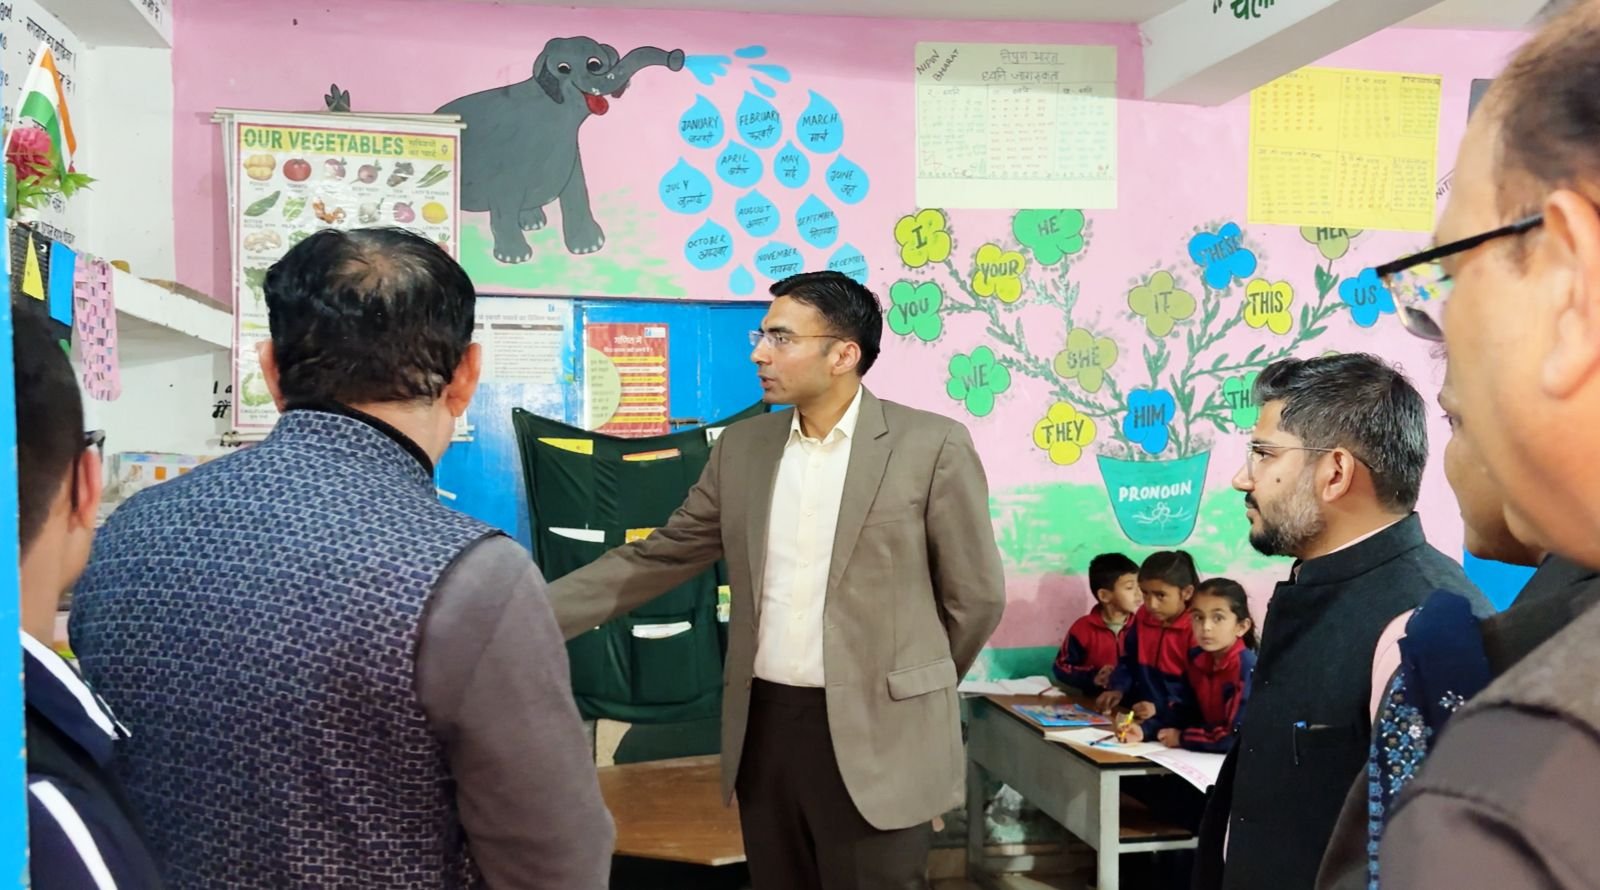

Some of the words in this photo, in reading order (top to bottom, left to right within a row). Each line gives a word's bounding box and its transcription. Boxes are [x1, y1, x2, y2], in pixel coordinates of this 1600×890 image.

[932, 48, 959, 82] BHARAT
[681, 116, 719, 131] JANUARY
[739, 110, 780, 127] FEBRUARY
[802, 112, 838, 127] MARCH
[243, 128, 283, 150] OUR
[288, 131, 405, 155] VEGETABLES
[721, 153, 749, 165] APRIL
[780, 154, 799, 165] MAY
[830, 170, 854, 182] JUNE
[738, 205, 771, 216] AUGUST
[1038, 215, 1059, 236] HE
[687, 234, 726, 249] OCTOBER
[911, 225, 928, 249] I
[757, 248, 798, 263] NOVEMBER
[829, 255, 865, 269] DECEMBER
[981, 259, 1020, 284] YOUR
[1154, 291, 1173, 313] IT
[1249, 291, 1283, 316] THIS
[1354, 284, 1377, 306] US
[899, 298, 930, 325] YOU
[1066, 350, 1101, 370] SHE
[962, 364, 990, 392] WE
[1133, 403, 1166, 429] HIM
[1041, 419, 1085, 444] THEY
[1118, 479, 1192, 502] PRONOUN
